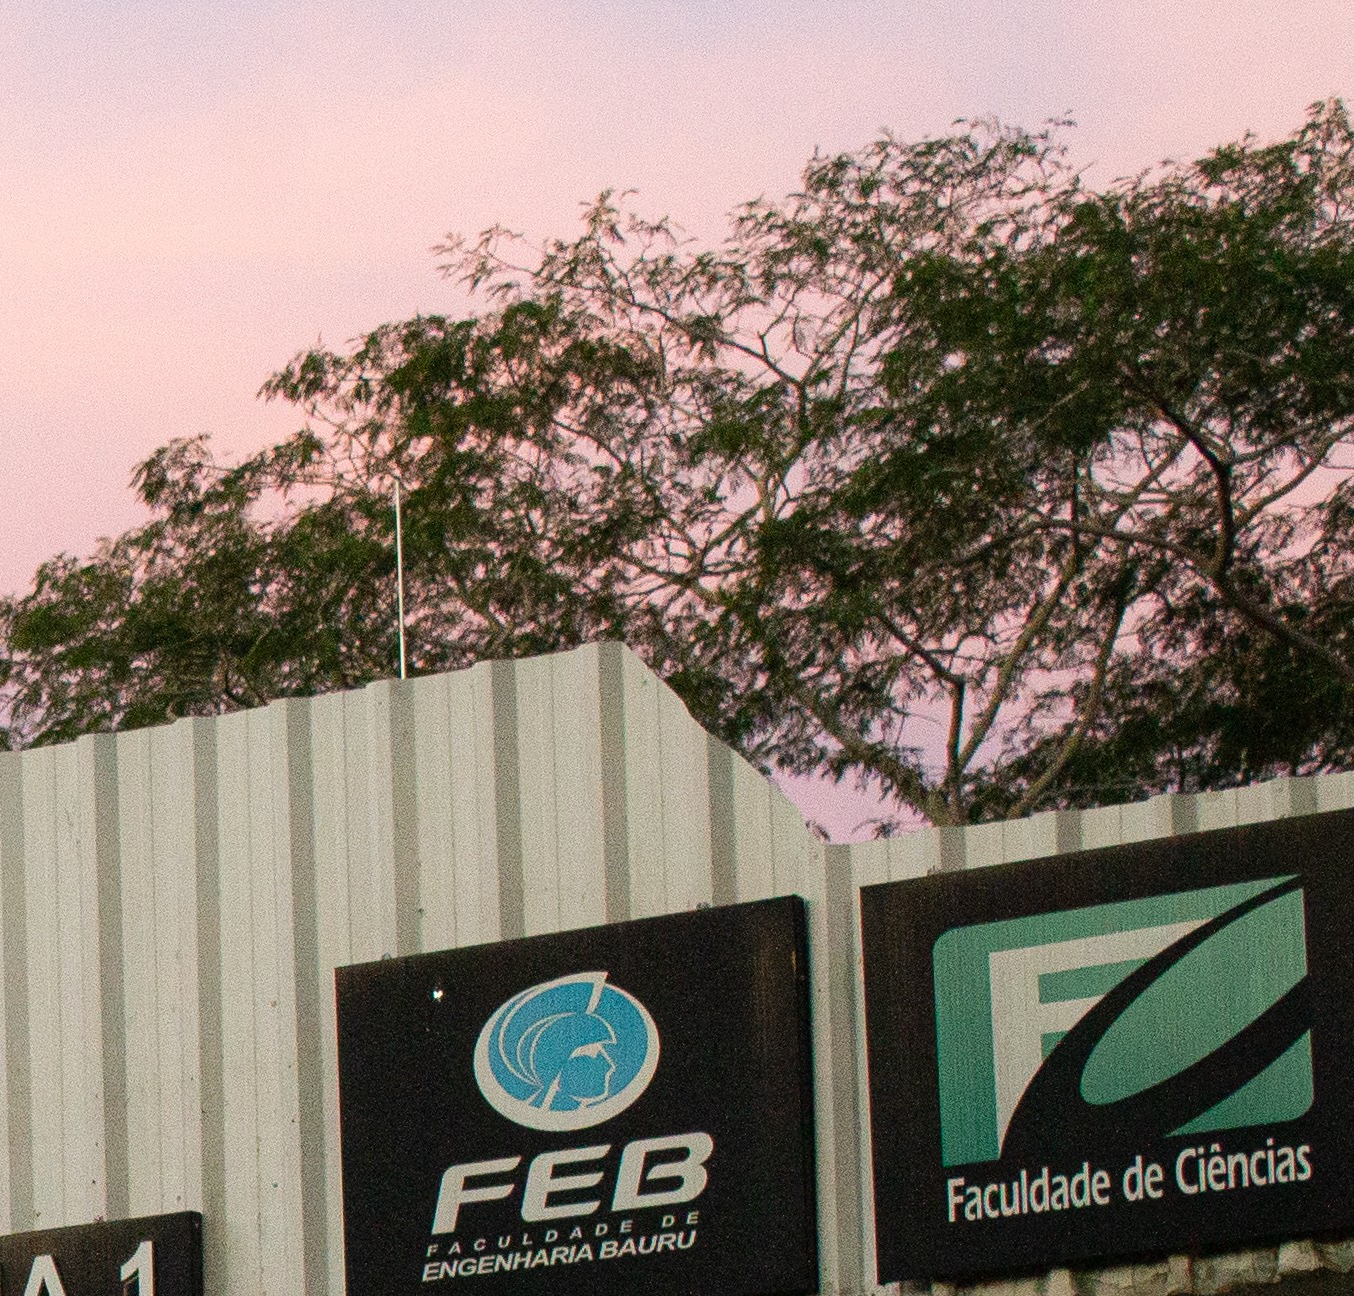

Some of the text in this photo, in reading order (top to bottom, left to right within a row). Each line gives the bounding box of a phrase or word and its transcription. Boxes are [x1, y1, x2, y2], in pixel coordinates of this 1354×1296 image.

[431, 1131, 714, 1235] FEB
[948, 1138, 1312, 1222] Faculdade de Ciências
[421, 1229, 697, 1283] ENGENHARIA BAURU
[427, 1211, 701, 1257] FACULDADE DE
